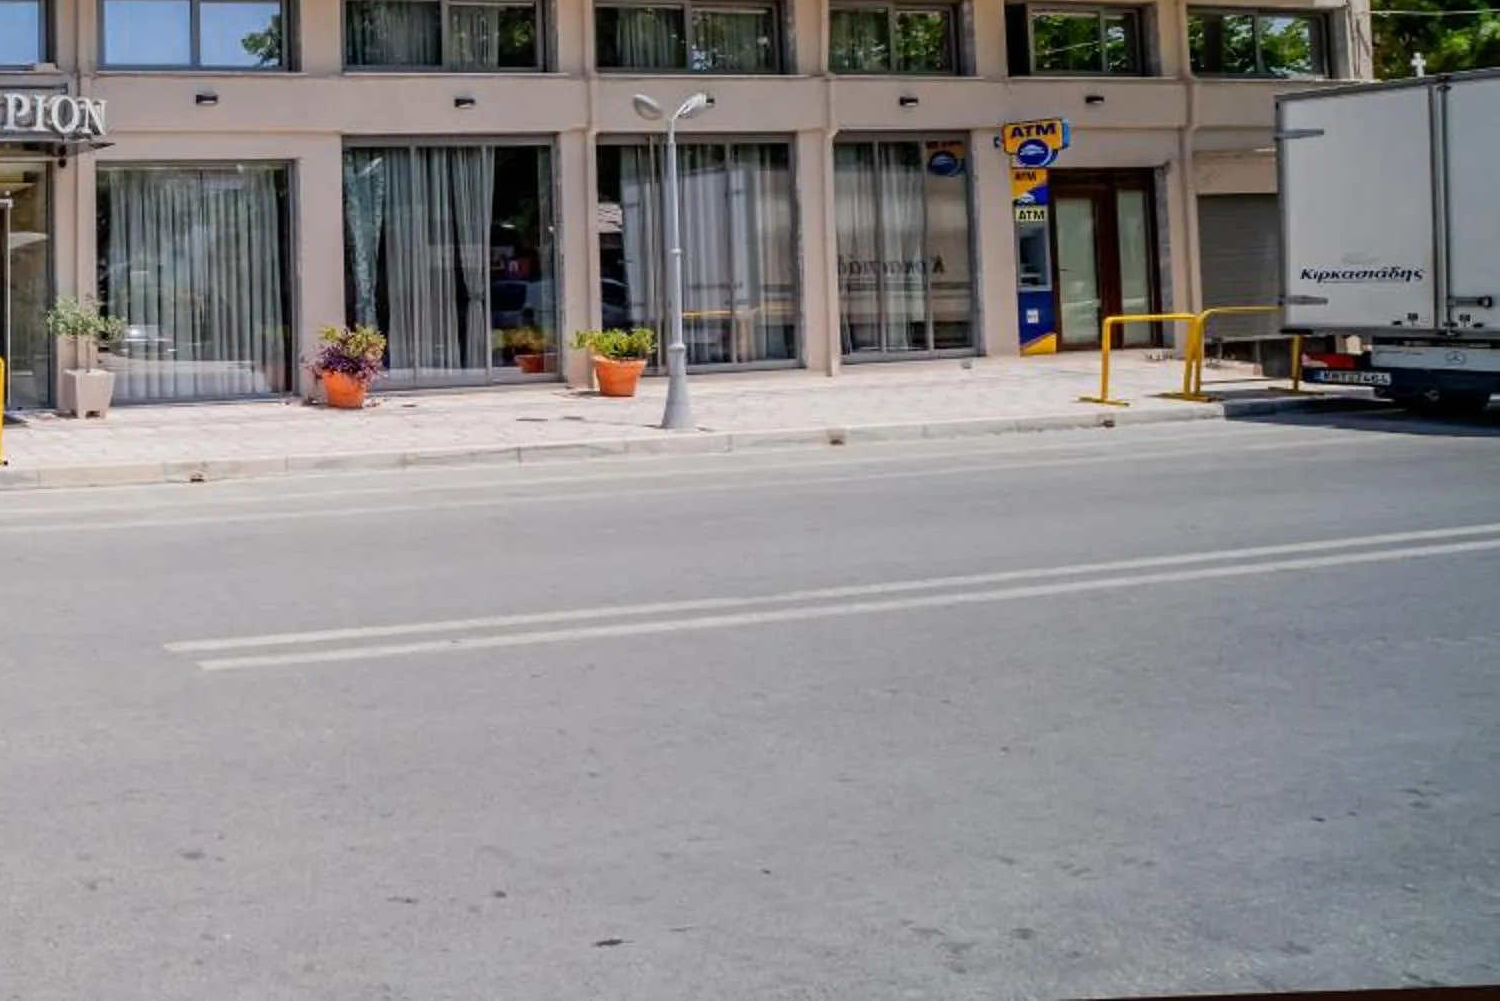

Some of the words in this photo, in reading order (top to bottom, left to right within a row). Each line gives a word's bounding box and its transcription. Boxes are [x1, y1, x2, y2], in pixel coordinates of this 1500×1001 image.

[1011, 123, 1057, 139] ATM
[1015, 171, 1037, 181] ATM
[1019, 210, 1046, 220] ATM
